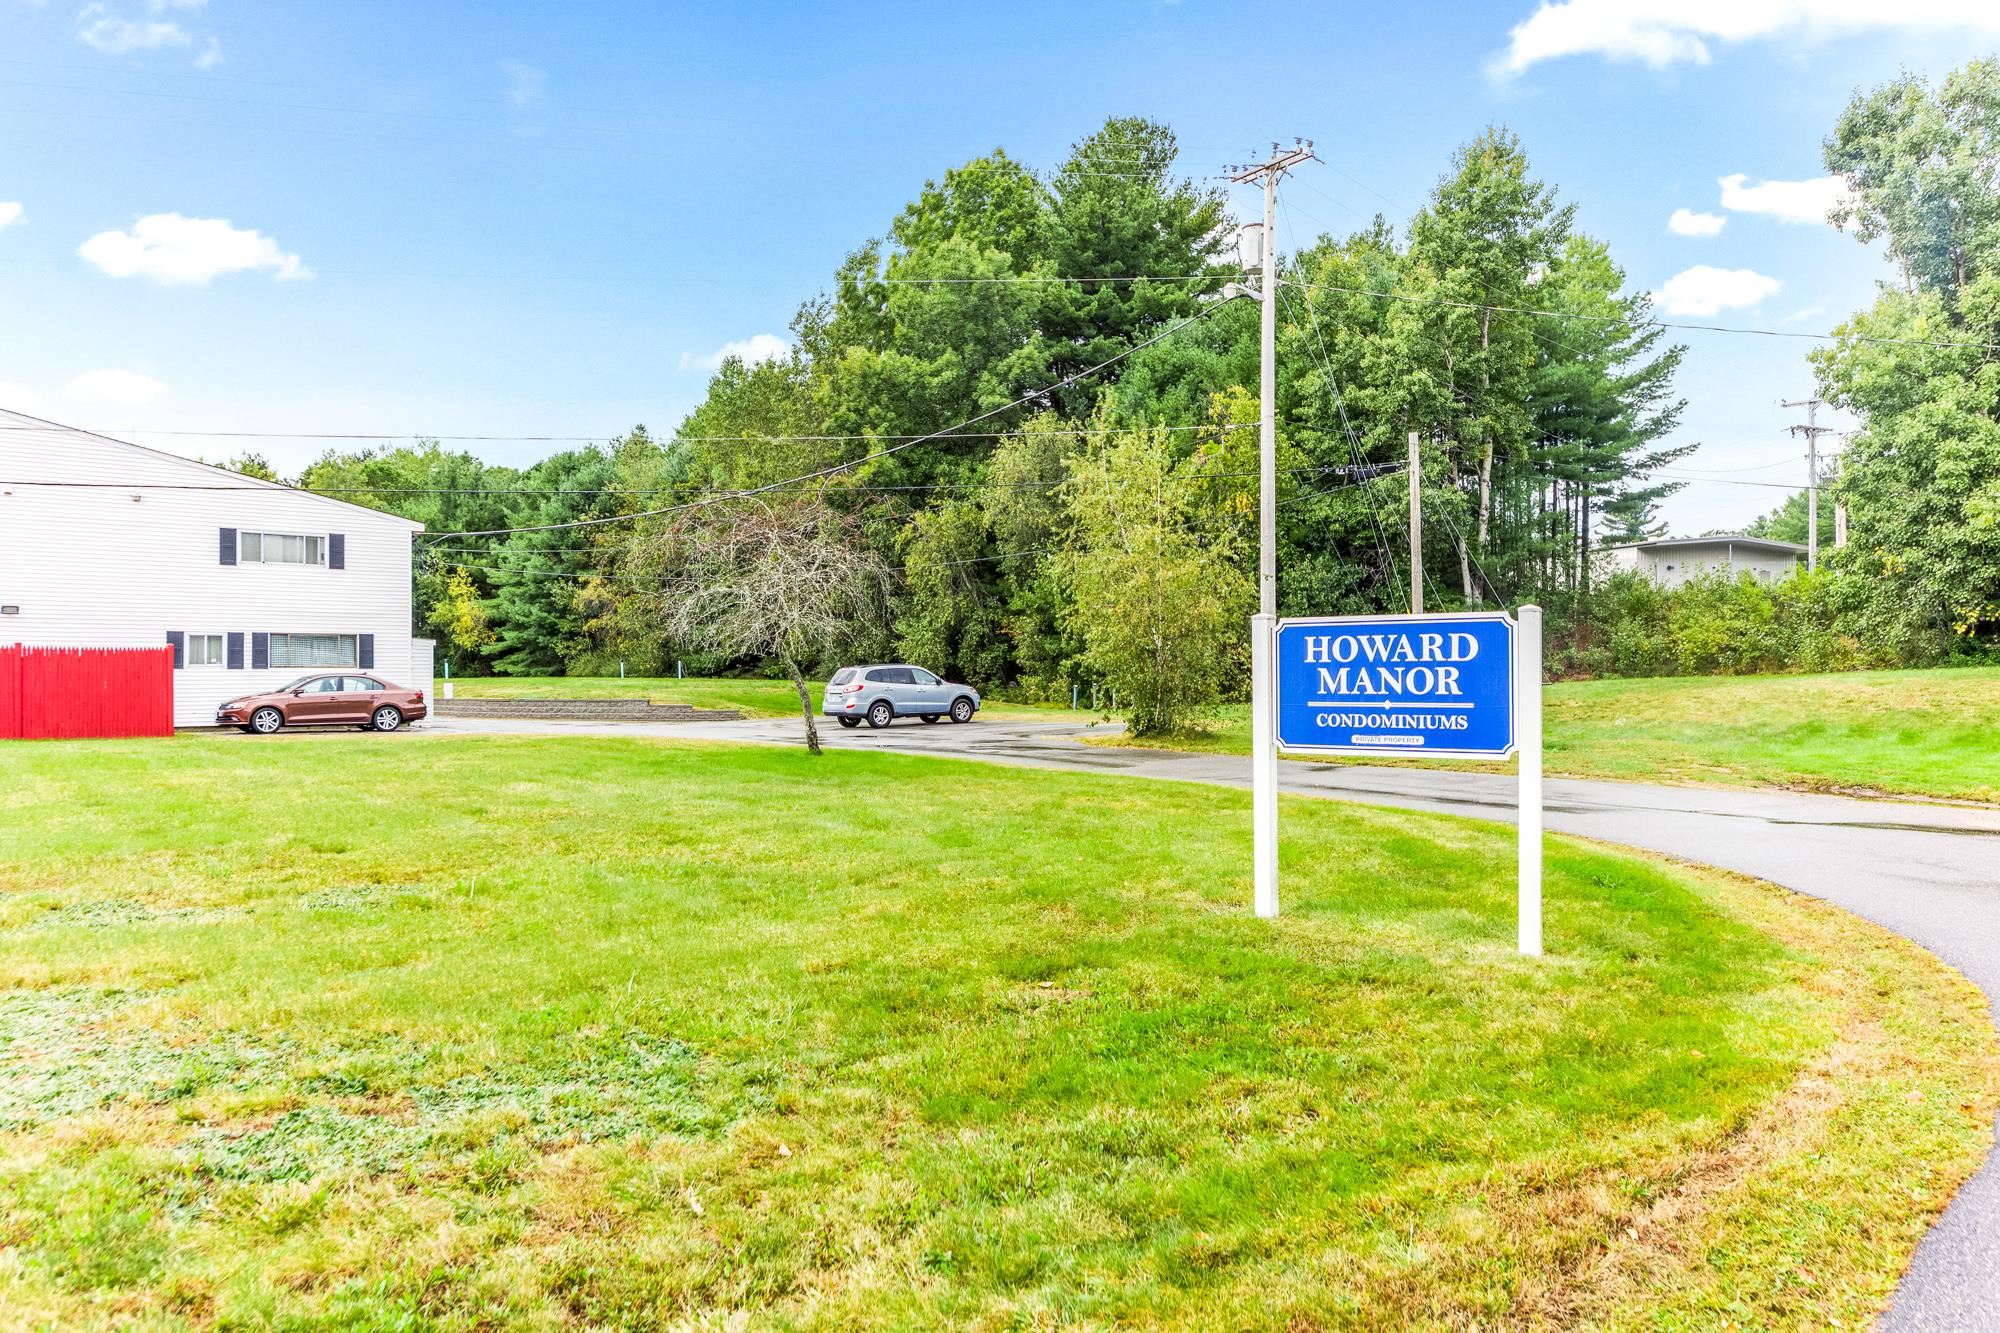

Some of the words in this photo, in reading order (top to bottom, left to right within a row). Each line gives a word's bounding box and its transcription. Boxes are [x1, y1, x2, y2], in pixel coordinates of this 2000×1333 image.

[1304, 633, 1479, 663] HOWARD
[1317, 666, 1463, 695] MANOR
[1316, 713, 1468, 730] CONDOMINIUMS
